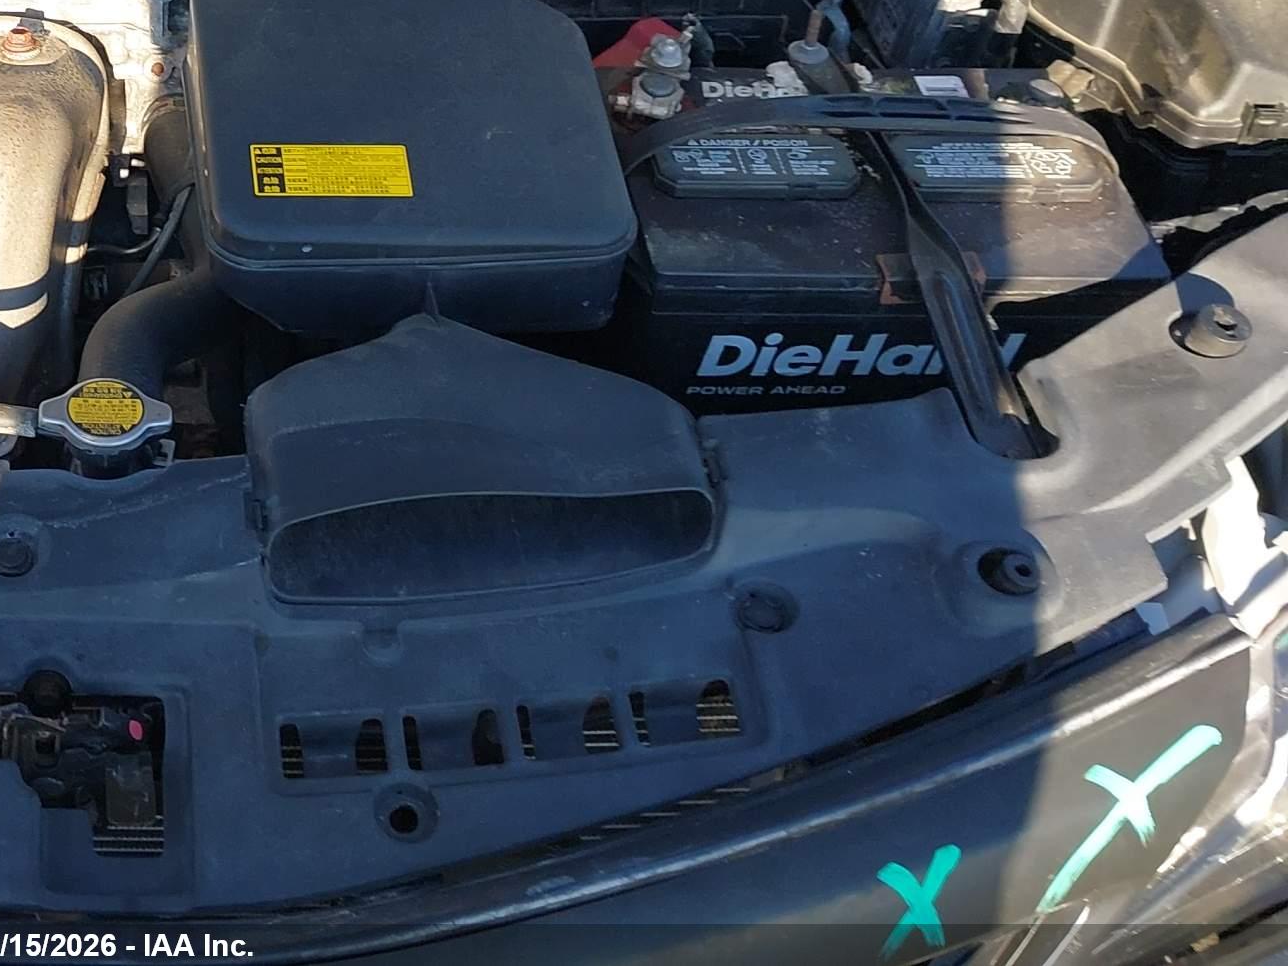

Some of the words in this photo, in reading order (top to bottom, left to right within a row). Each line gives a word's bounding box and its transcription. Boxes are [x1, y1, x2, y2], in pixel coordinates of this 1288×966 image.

[700, 139, 752, 147] DANGER
[763, 139, 809, 147] POISON
[685, 385, 764, 396] POWER
[769, 385, 847, 395] AHEAD
